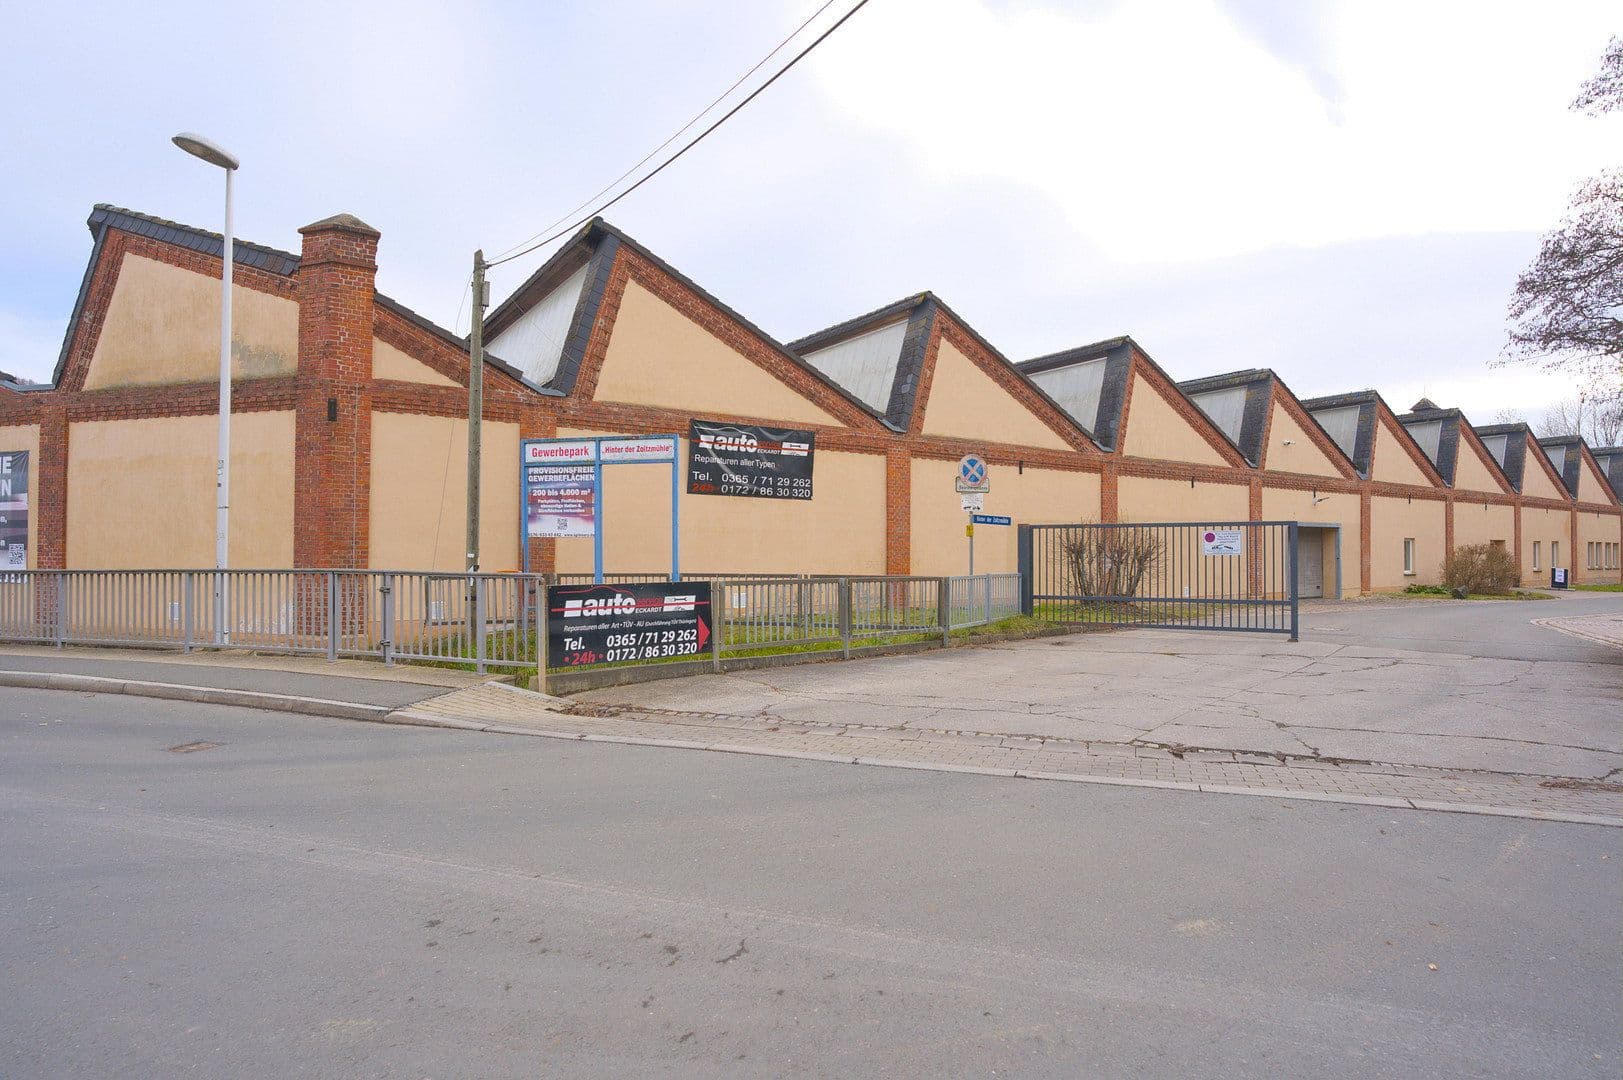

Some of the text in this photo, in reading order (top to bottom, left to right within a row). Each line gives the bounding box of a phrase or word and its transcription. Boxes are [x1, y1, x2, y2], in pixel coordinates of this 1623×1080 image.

[625, 445, 635, 453] der
[714, 434, 758, 453] auto
[532, 446, 589, 458] Gewerbepark
[694, 453, 776, 469] Reparaturen aller Typen
[528, 466, 594, 474] PROVISIONSFREIE
[528, 474, 594, 482] GEWERBEFLÄCHEN
[692, 471, 713, 482] Tel.
[721, 473, 749, 484] 0365
[761, 476, 774, 486] 71
[777, 477, 790, 487] 29
[793, 478, 811, 488] 262
[532, 489, 546, 497] 200
[721, 484, 749, 495] 0172
[760, 487, 773, 496] 86
[776, 488, 790, 497] 30
[792, 488, 811, 498] 320
[582, 593, 636, 617] auto
[635, 606, 663, 614] ECKARDT
[563, 622, 598, 632] Reparaturen
[610, 621, 620, 629] Art
[622, 619, 634, 629] TÜV
[636, 619, 645, 627] AU
[563, 637, 586, 651] Tel.
[606, 633, 636, 648] 0365
[645, 632, 658, 645] 71
[661, 630, 676, 643] 29
[677, 629, 697, 642] 262
[571, 650, 596, 665] 24h
[606, 648, 637, 662] 0172
[644, 645, 659, 658] 86
[661, 644, 675, 657] 30
[677, 642, 697, 655] 320
